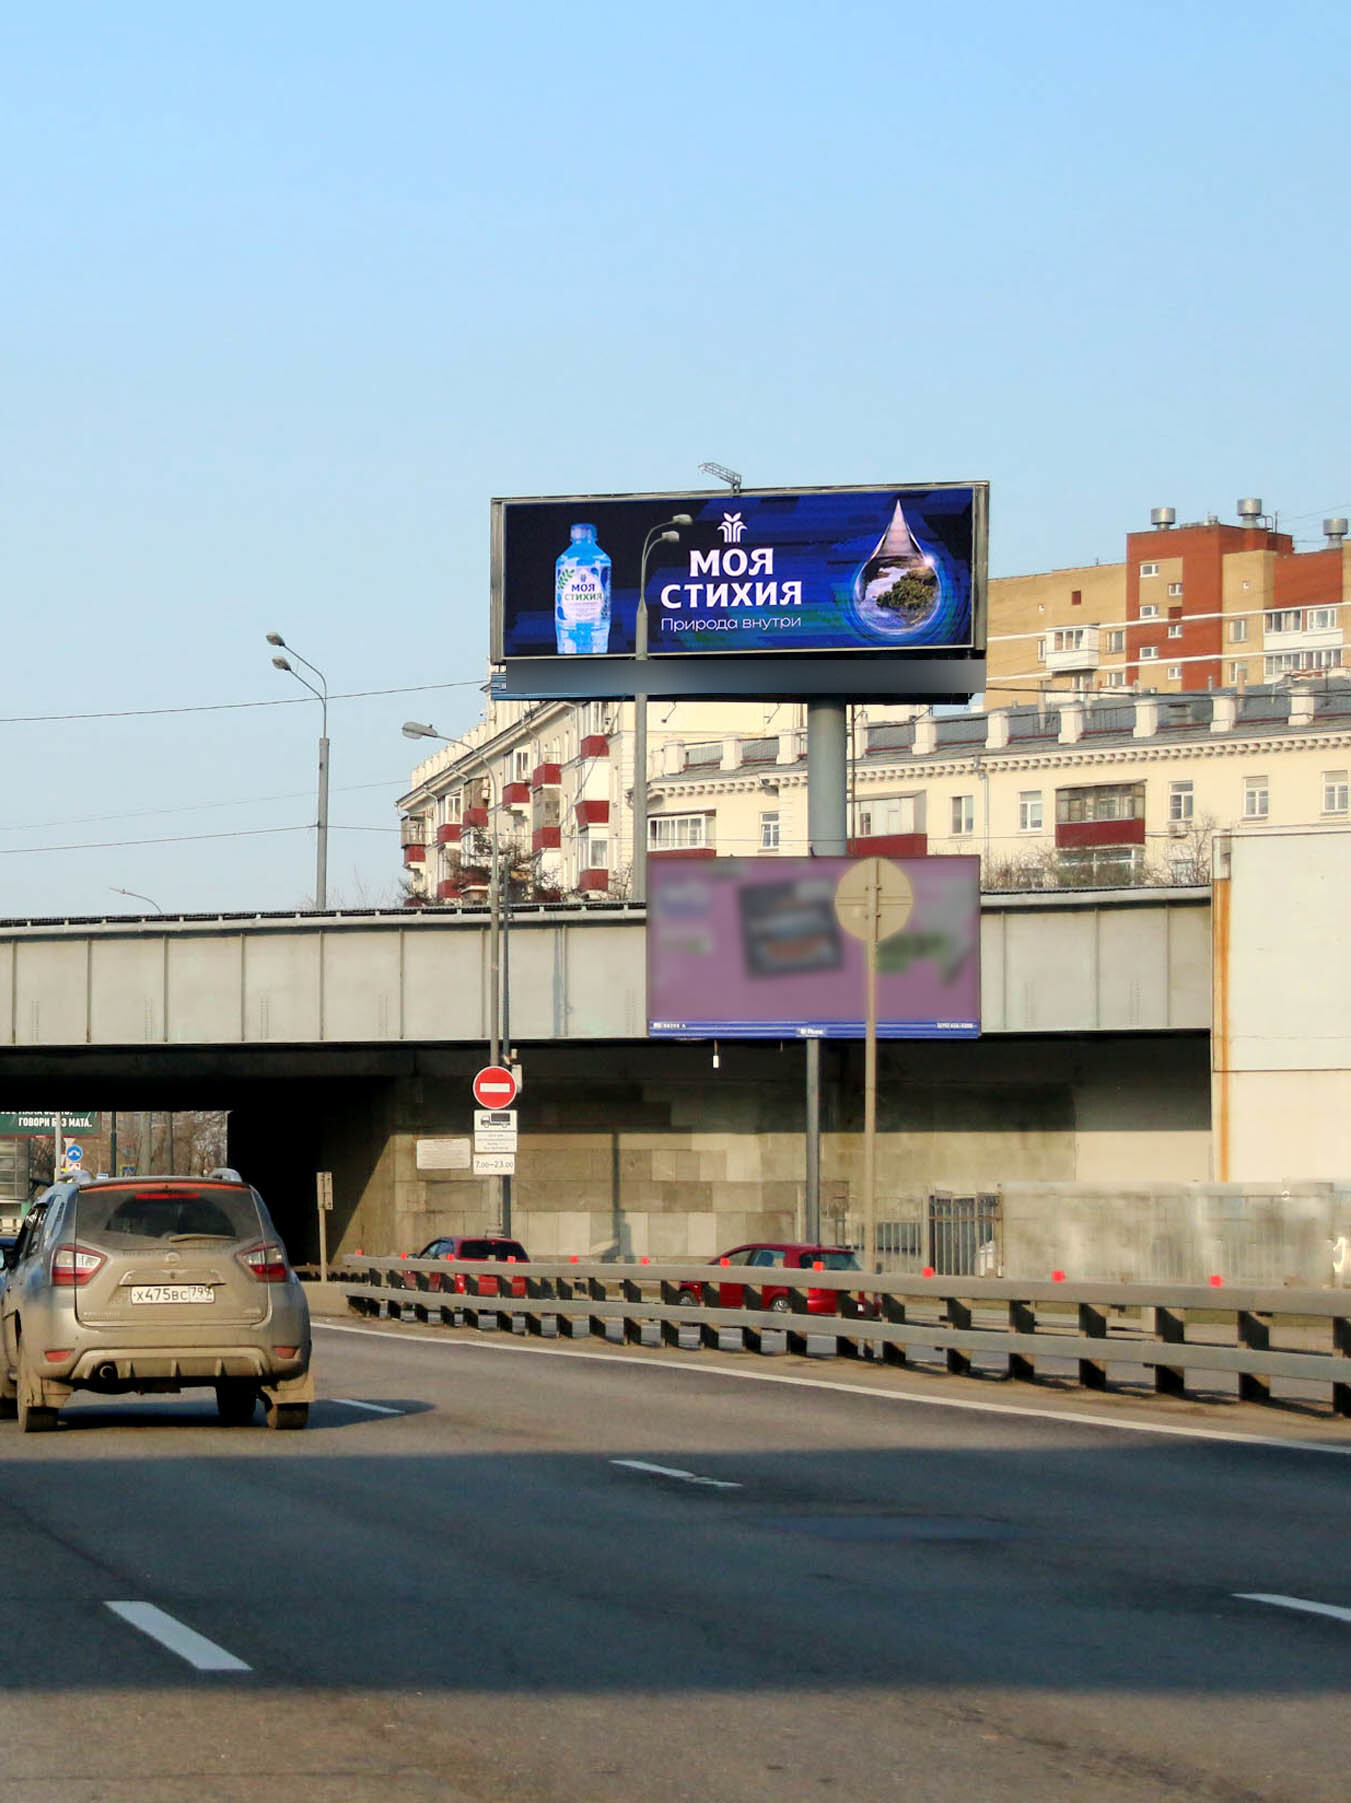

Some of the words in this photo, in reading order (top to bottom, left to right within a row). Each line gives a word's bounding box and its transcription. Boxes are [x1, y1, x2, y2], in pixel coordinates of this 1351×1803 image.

[689, 547, 774, 577] МОЯ
[571, 583, 595, 592] МОЯ
[660, 580, 803, 609] СТИХИЯ
[564, 592, 603, 601] СТИХИЯ
[661, 617, 738, 633] Природа
[742, 616, 802, 631] внутри
[18, 1117, 50, 1127] ГОВОРИ
[51, 1117, 67, 1128] БЗ
[68, 1117, 93, 1128] МАТА.
